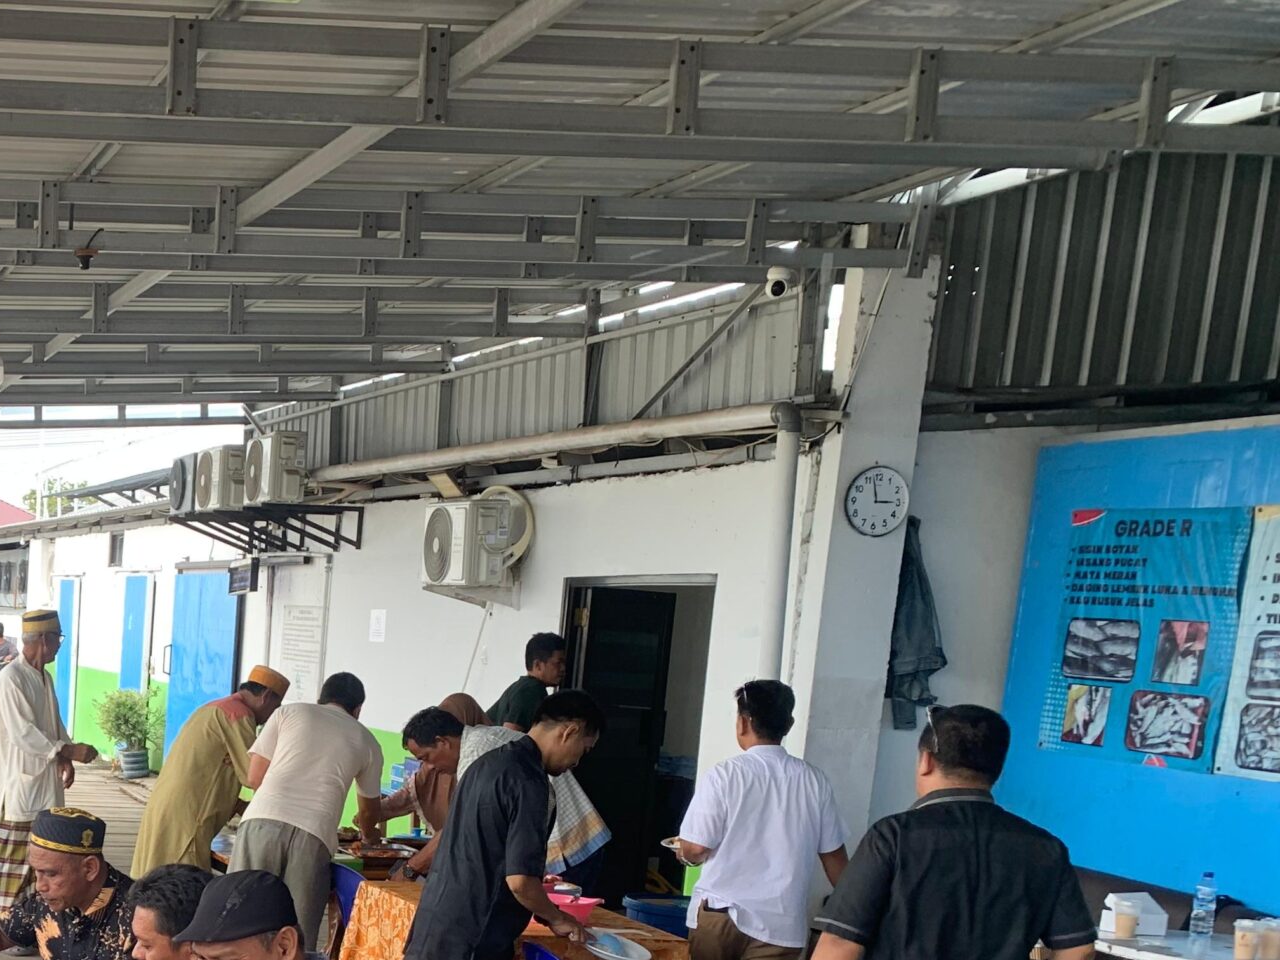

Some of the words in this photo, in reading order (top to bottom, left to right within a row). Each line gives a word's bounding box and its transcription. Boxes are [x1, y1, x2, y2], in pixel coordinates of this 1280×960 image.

[876, 473, 883, 482] 12
[855, 485, 864, 493] 10
[890, 510, 896, 518] 4
[861, 518, 866, 527] 7
[1115, 519, 1175, 537] GRADE
[1180, 519, 1193, 537] R
[1073, 571, 1101, 580] MATA
[1103, 571, 1137, 581] MERAH
[1071, 584, 1108, 593] DAGING
